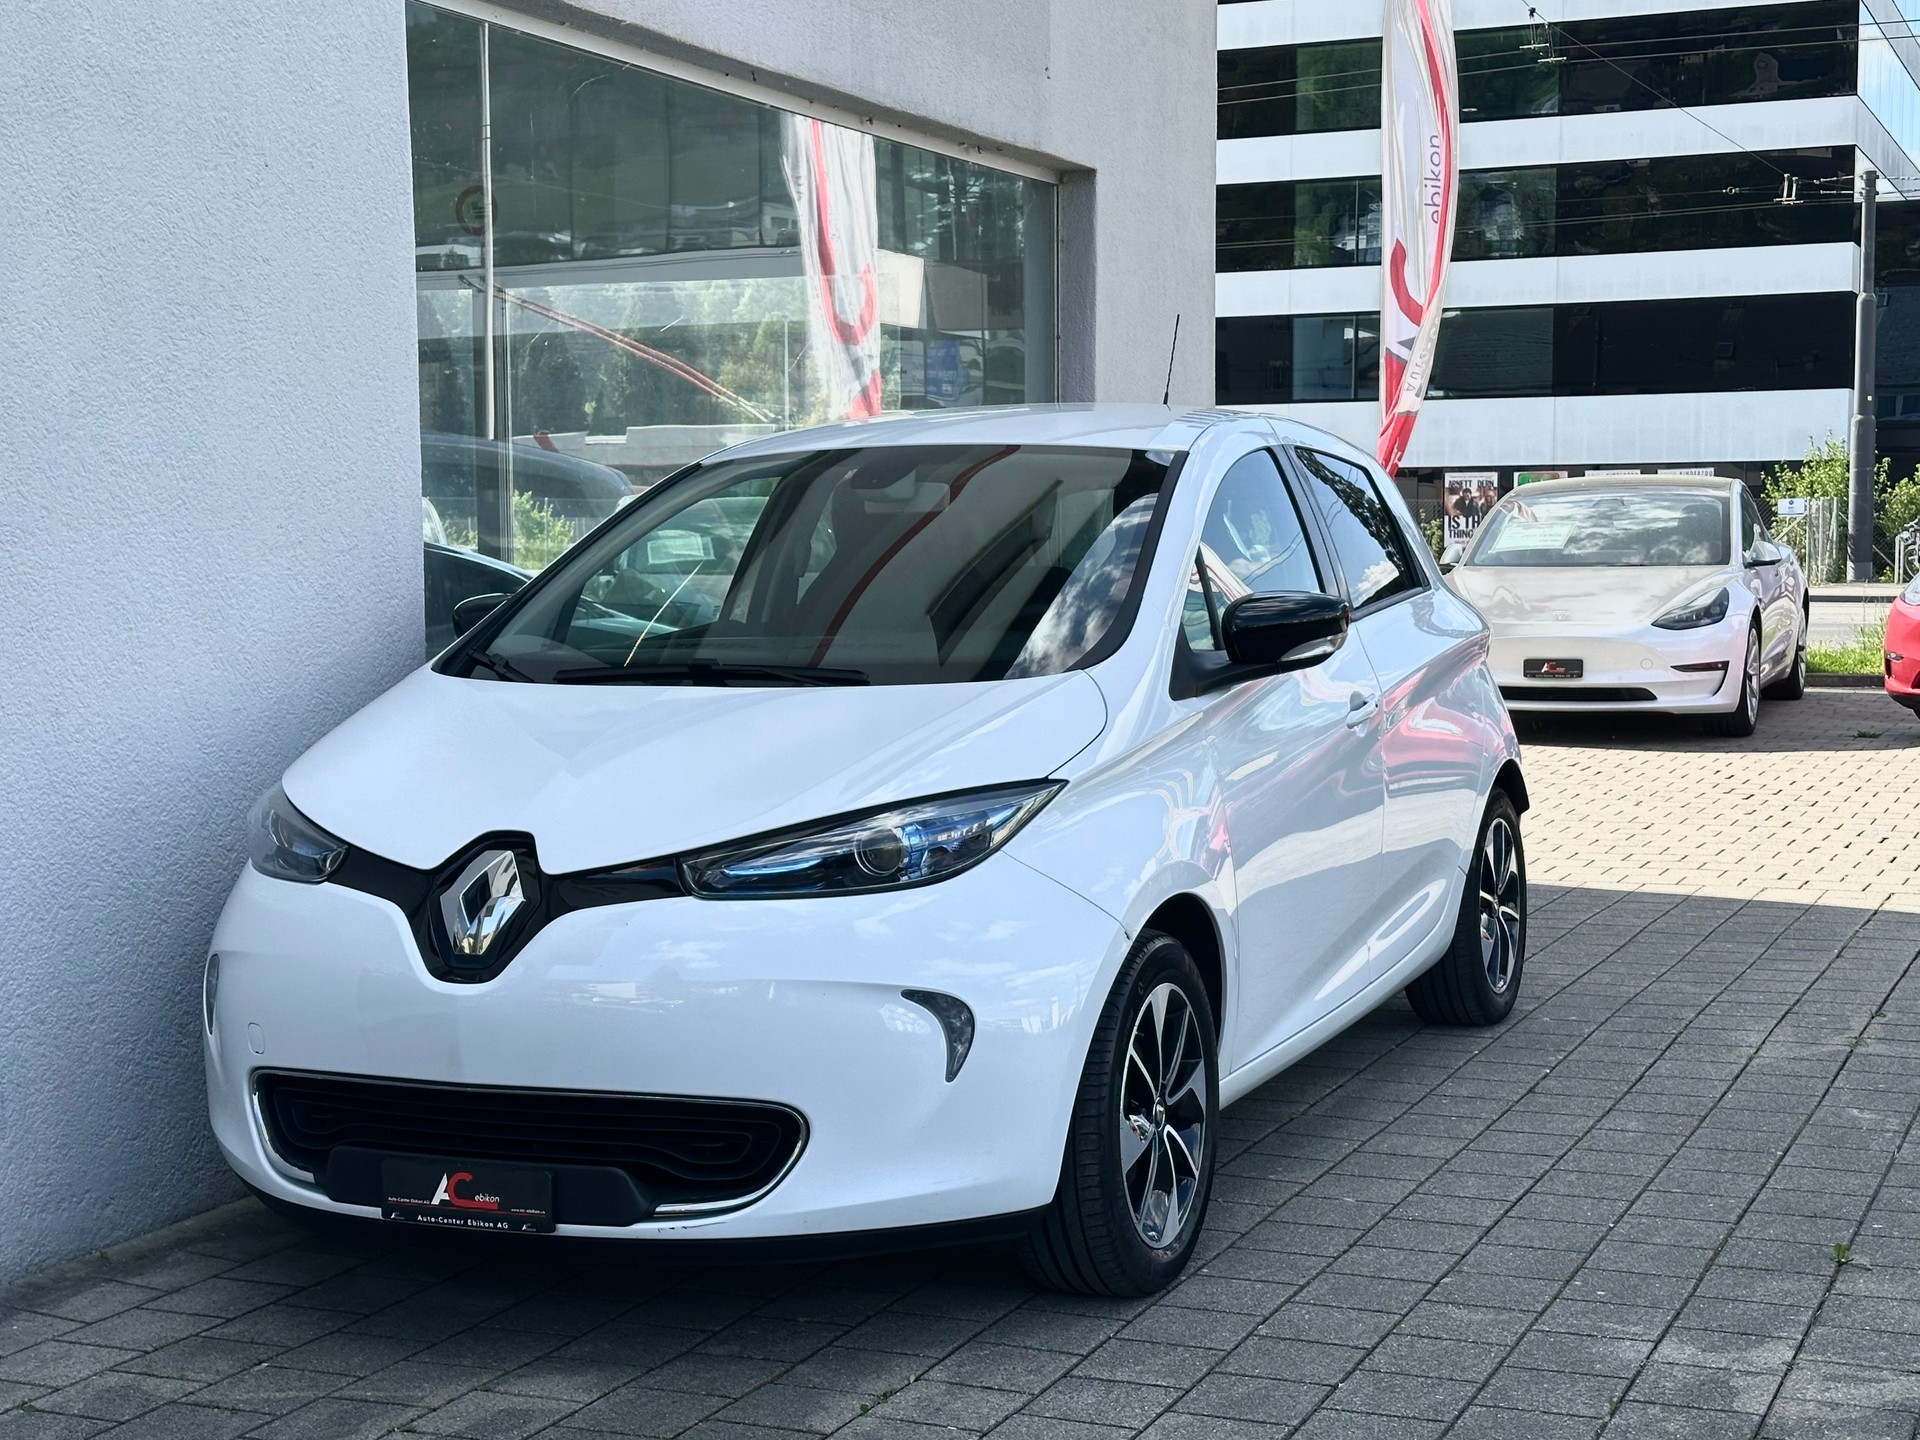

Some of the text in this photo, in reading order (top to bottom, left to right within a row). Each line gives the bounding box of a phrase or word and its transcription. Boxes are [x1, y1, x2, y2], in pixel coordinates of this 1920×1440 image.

[1423, 135, 1441, 224] ebikon
[1448, 515, 1460, 529] IS
[475, 1193, 500, 1203] ebikon
[417, 1214, 509, 1229] Auto-Center Ebikon AG
